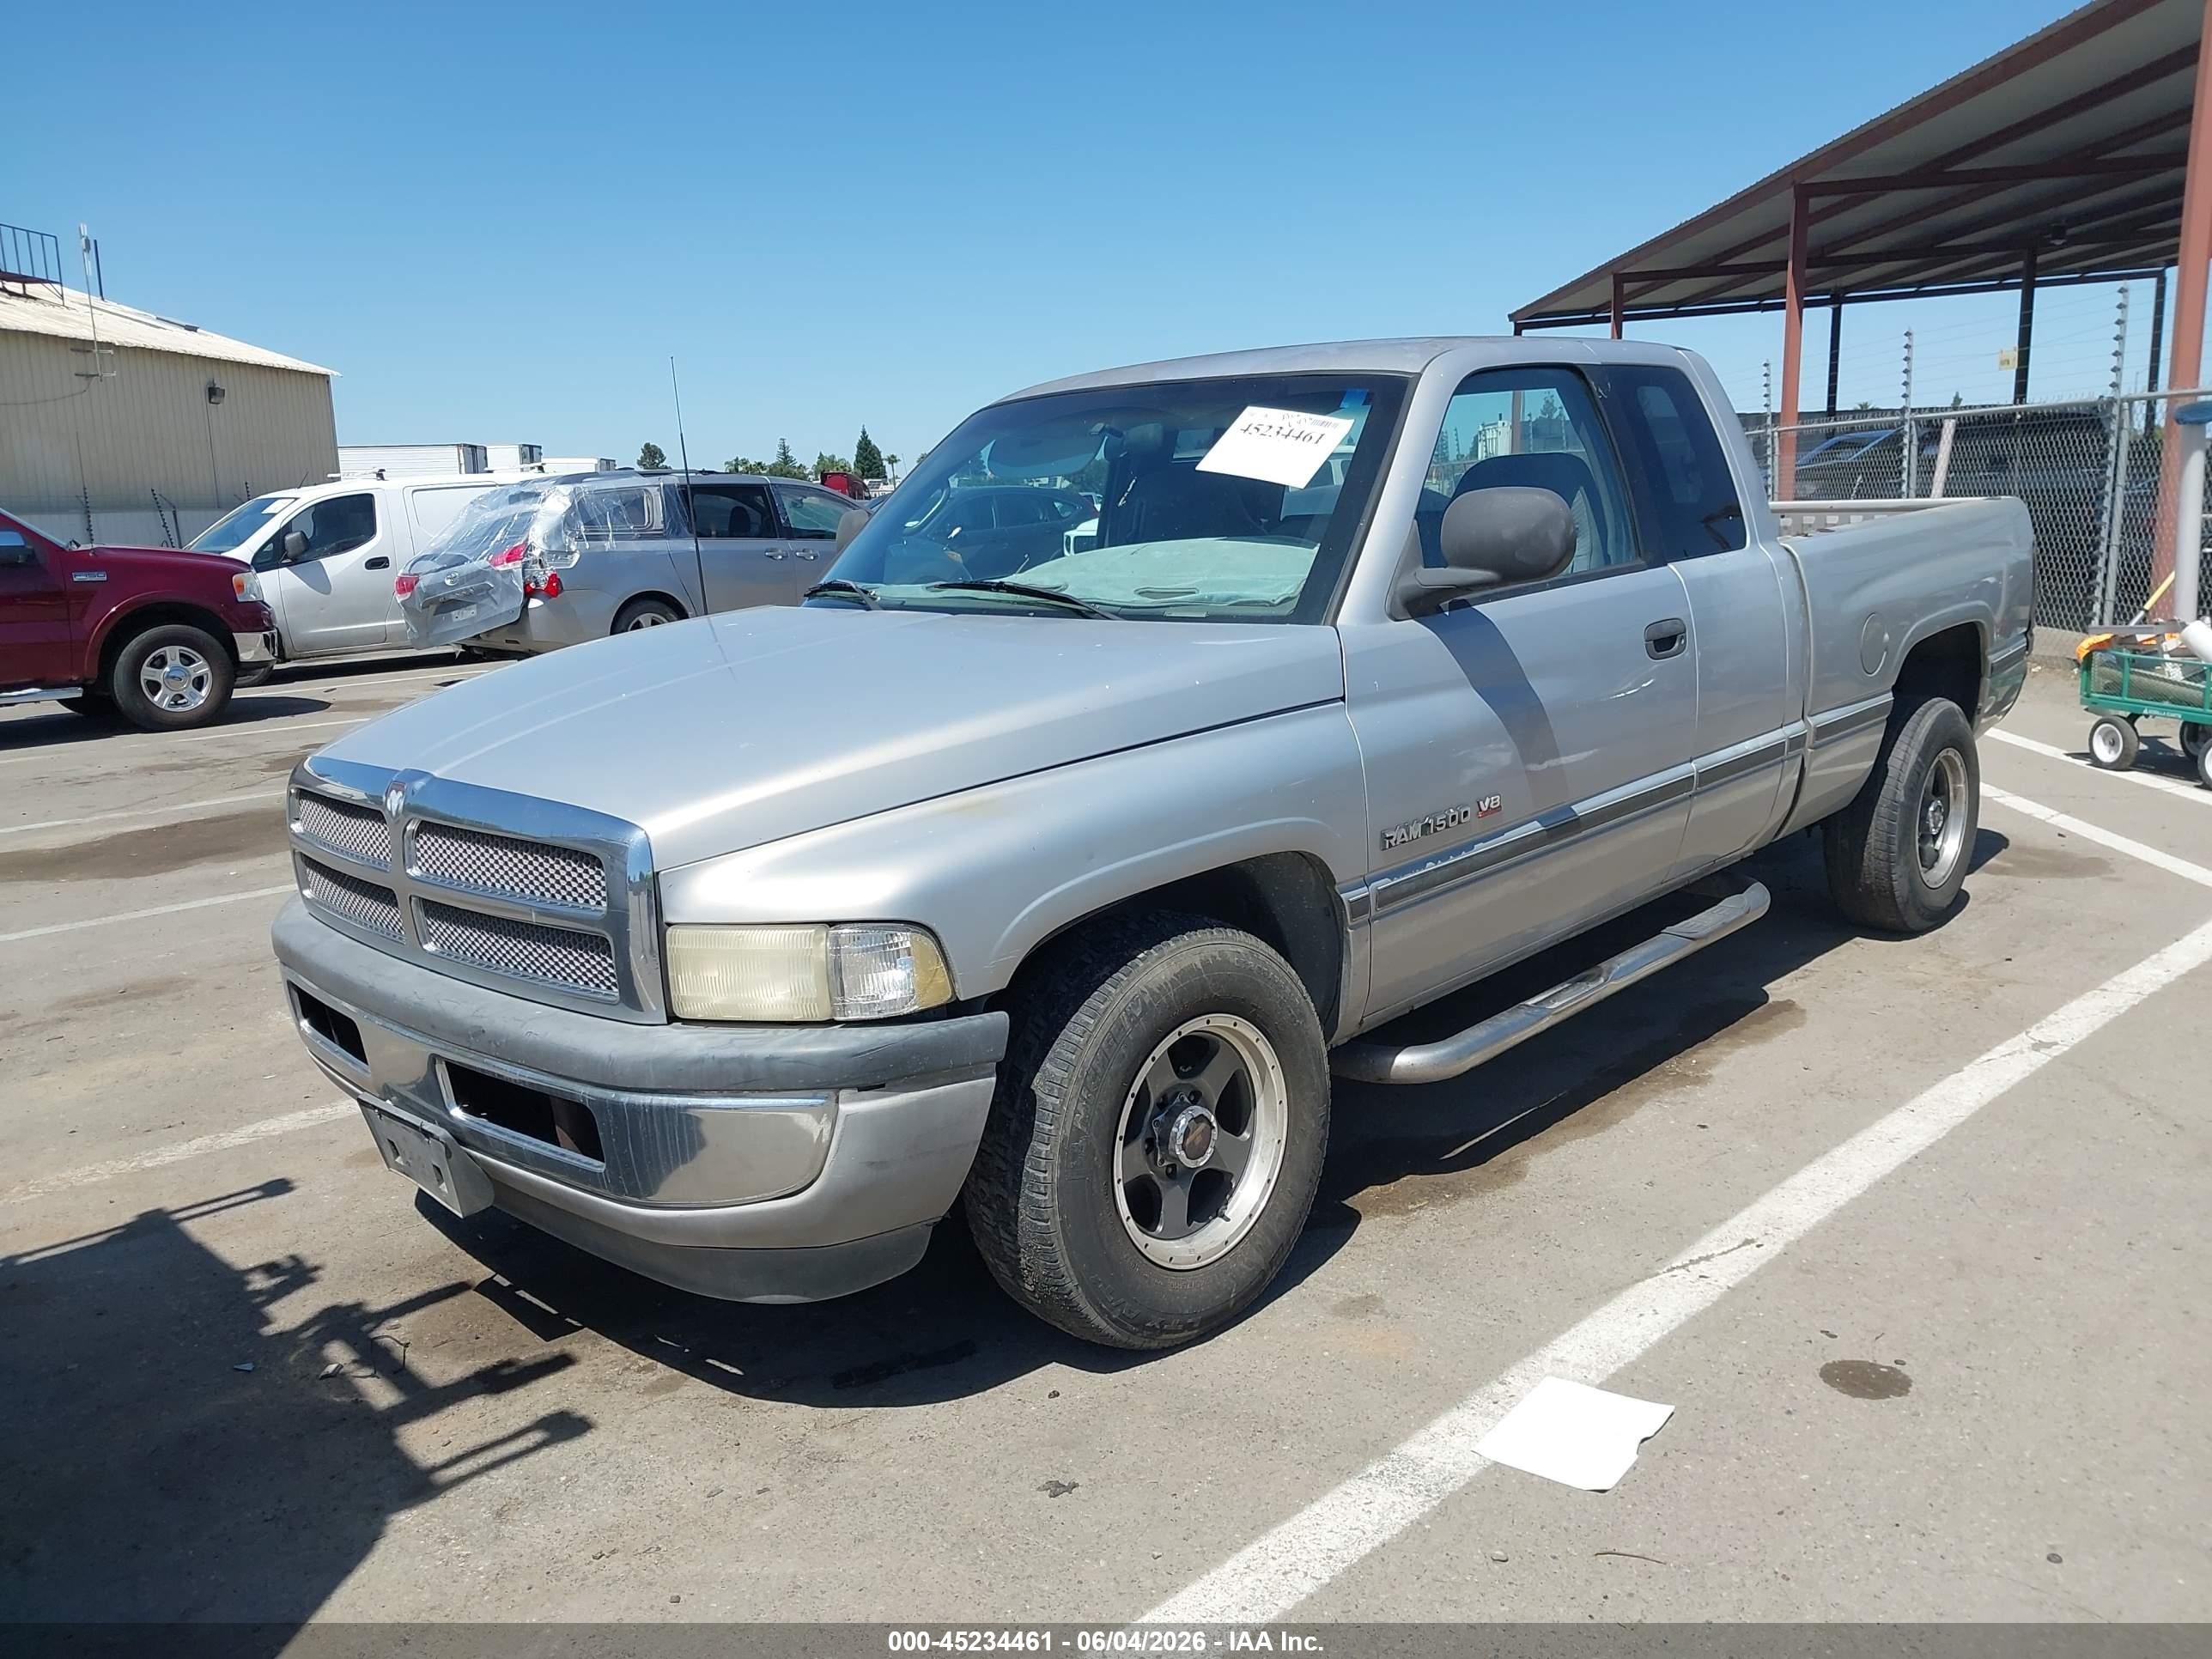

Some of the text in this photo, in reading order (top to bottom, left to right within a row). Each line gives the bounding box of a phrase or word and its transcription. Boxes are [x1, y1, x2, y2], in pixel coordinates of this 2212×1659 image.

[1240, 422, 1325, 445] 45234461
[1477, 794, 1502, 811] V8
[1382, 820, 1422, 849] RAM
[1426, 805, 1471, 834] 1500
